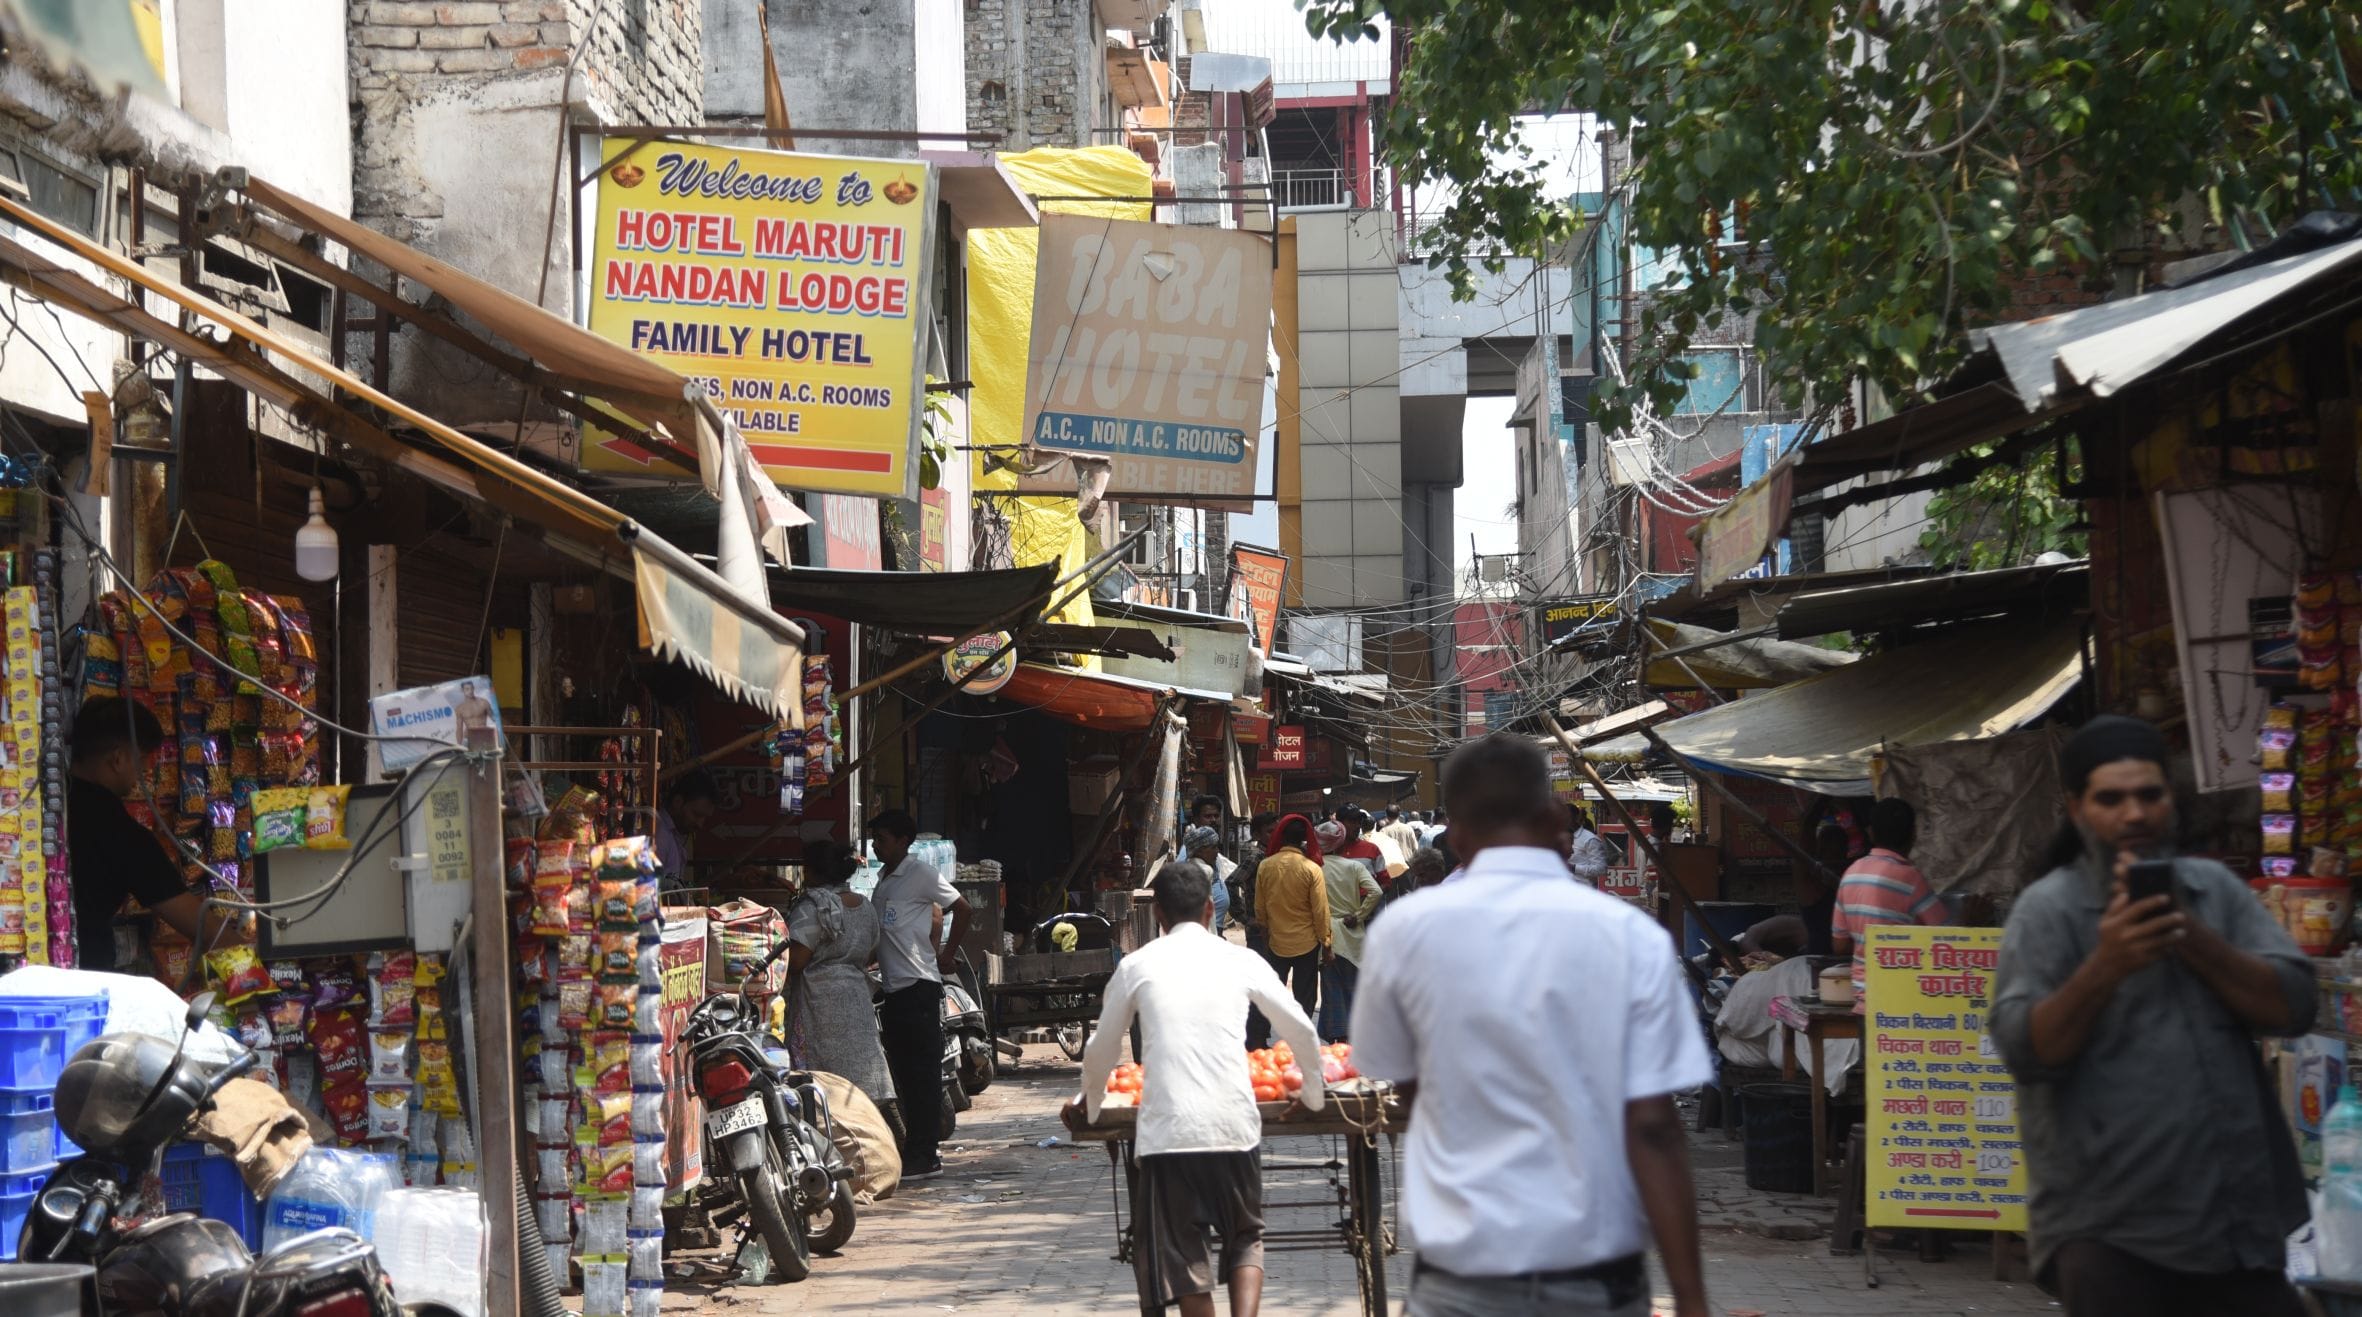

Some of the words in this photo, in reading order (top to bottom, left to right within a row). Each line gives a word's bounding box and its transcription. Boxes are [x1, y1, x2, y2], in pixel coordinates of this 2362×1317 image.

[656, 153, 822, 203] Welcome
[837, 171, 873, 205] to
[617, 210, 743, 252] HOTEL
[754, 217, 904, 265] MARUTI
[606, 260, 767, 308] NANDAN
[777, 270, 908, 317] LODGE
[1066, 234, 1242, 328] BABA
[631, 320, 751, 357] FAMILY
[762, 328, 873, 365] HOTEL
[1038, 324, 1250, 422] HOTEL
[732, 379, 773, 400] NON
[779, 382, 816, 403] A.C.
[822, 385, 891, 407] ROOMS
[1040, 417, 1084, 445] A.C.,
[1091, 420, 1127, 446] NON
[1132, 427, 1169, 450] A.C.
[1176, 431, 1240, 457] ROOMS
[1175, 464, 1240, 493] HERE
[1546, 606, 1588, 621] आनन्द
[445, 819, 451, 828] 3
[439, 852, 464, 862] 0092
[1875, 947, 1923, 968] राज
[1918, 971, 1986, 997] कार्नर
[1876, 1012, 1908, 1029] चिकन
[1877, 1034, 1924, 1055] चिकन
[1883, 1095, 1929, 1114] मछली
[1932, 1149, 1962, 1168] करी
